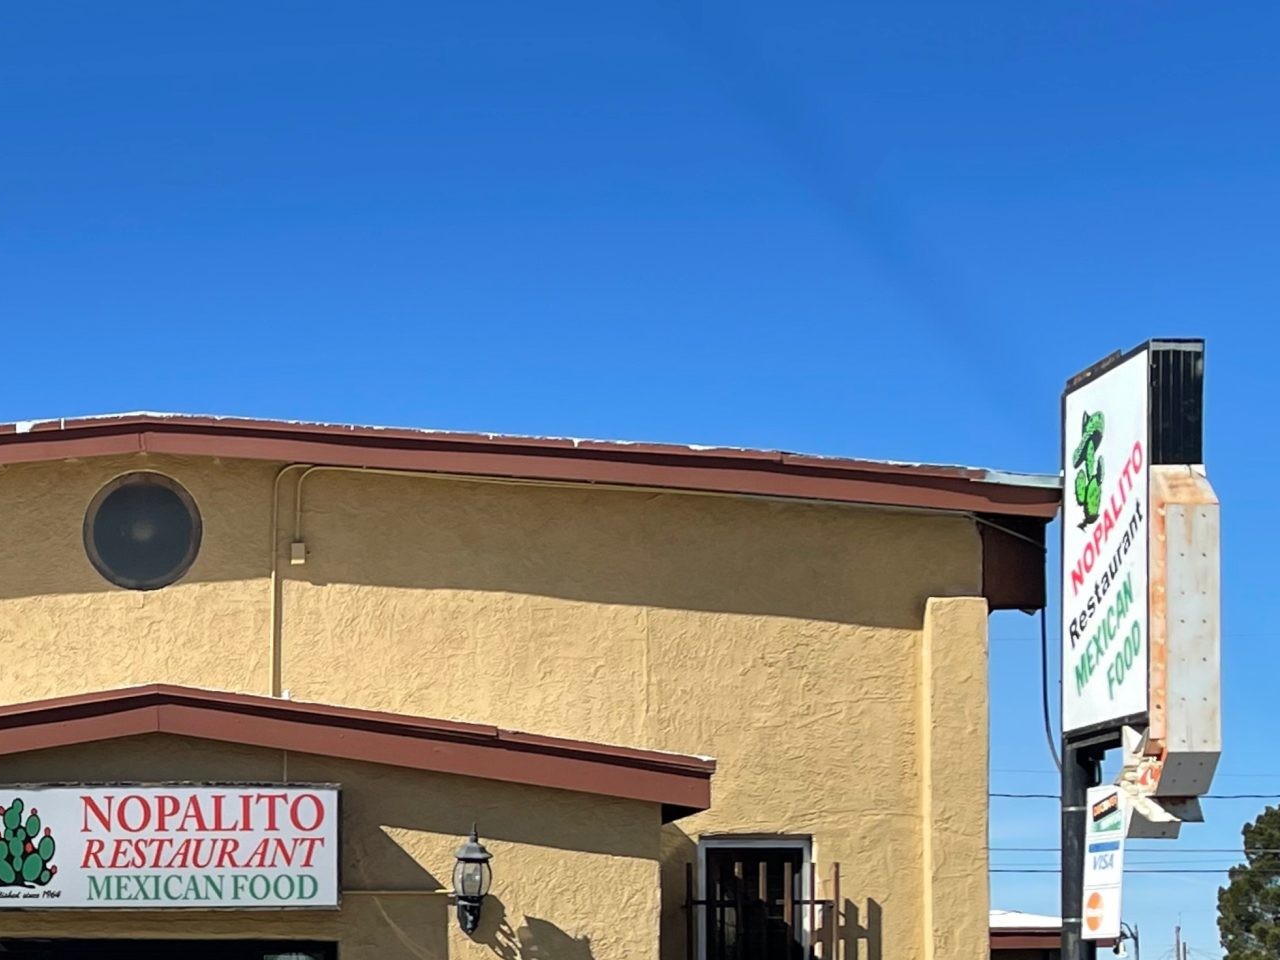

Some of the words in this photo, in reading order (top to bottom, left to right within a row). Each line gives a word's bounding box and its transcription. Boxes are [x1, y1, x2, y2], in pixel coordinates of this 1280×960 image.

[1071, 440, 1143, 597] NOPALITO
[1068, 499, 1143, 650] Restaurant
[1075, 571, 1133, 697] MEXICAN
[1107, 620, 1141, 701] FOOD
[80, 793, 325, 833] NOPALITO
[80, 837, 325, 869] RESTAURANT
[1093, 853, 1115, 871] VISA
[87, 874, 225, 901] MEXICAN
[231, 874, 319, 901] FOOD
